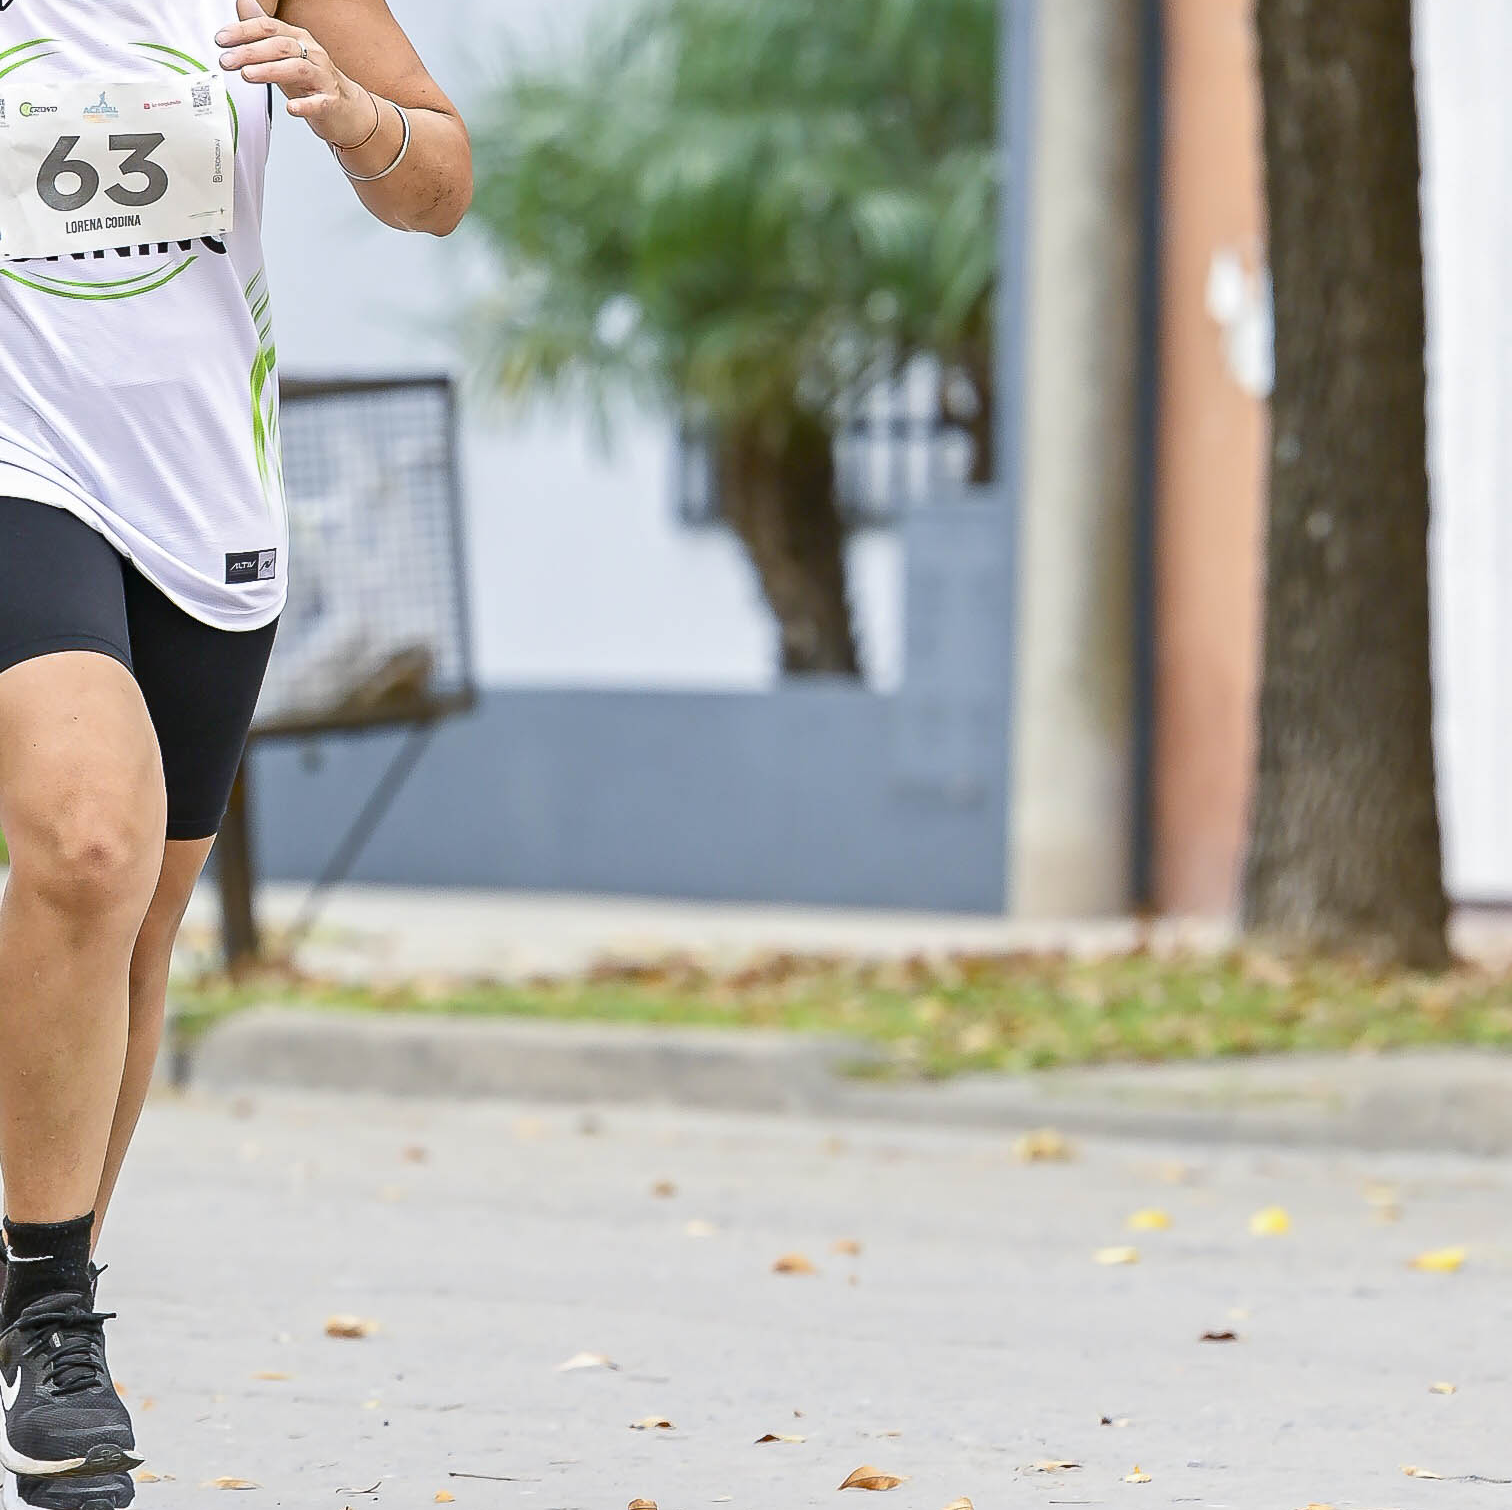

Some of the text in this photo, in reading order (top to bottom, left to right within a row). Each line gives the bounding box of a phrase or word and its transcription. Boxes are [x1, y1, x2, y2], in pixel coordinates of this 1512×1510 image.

[36, 133, 169, 212] 63
[65, 214, 141, 234] LORENA CODINA
